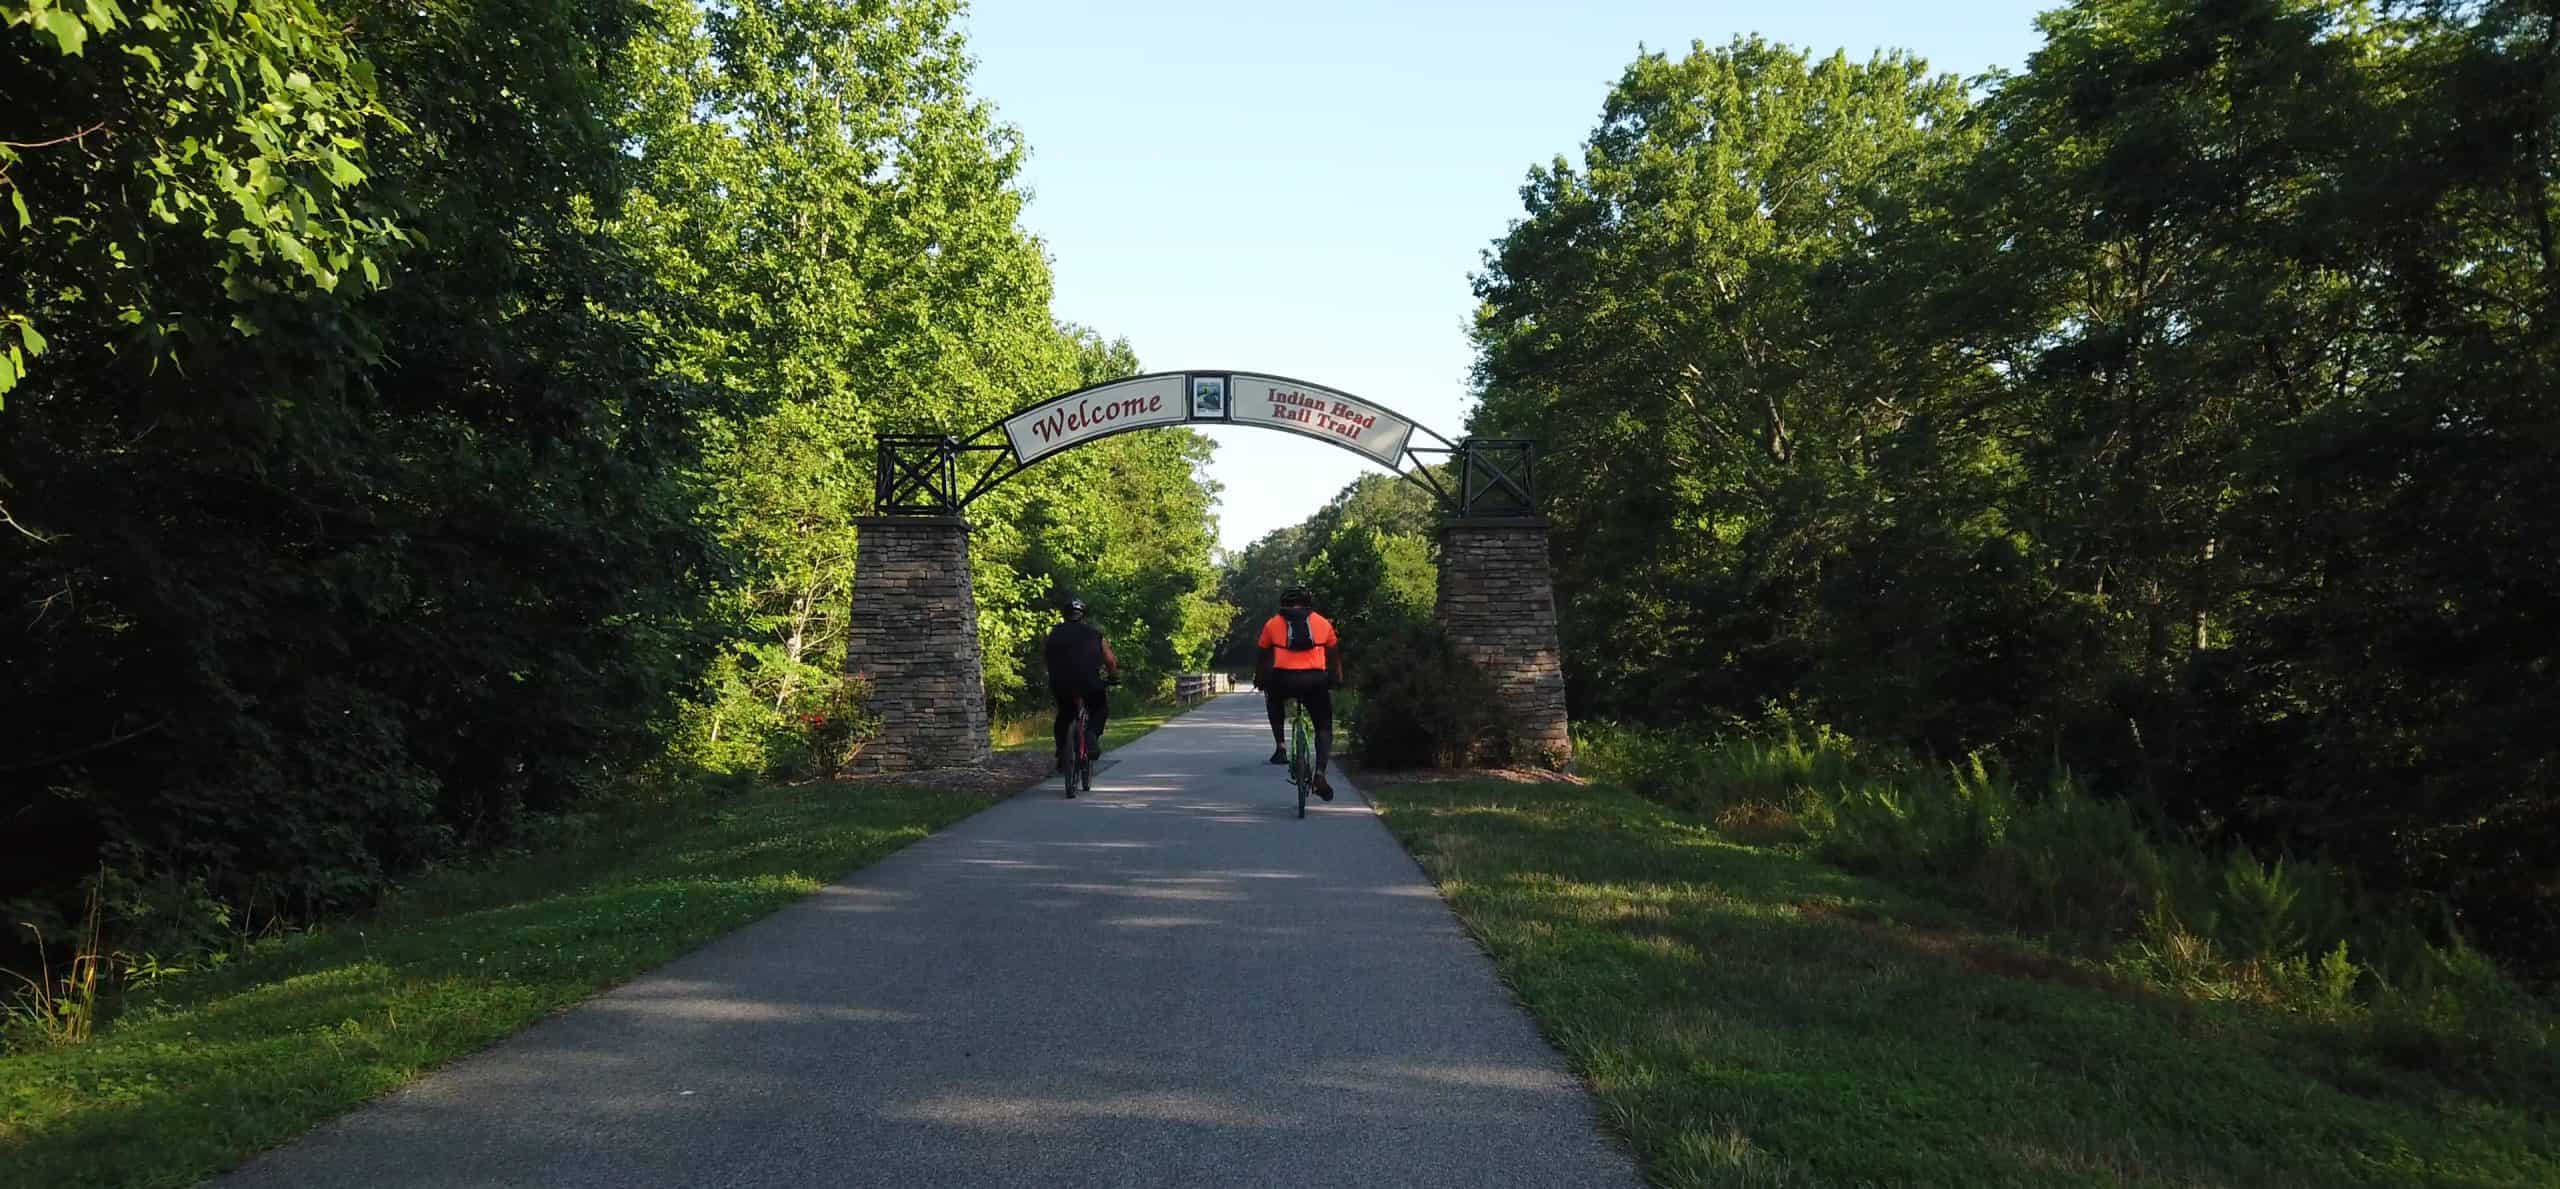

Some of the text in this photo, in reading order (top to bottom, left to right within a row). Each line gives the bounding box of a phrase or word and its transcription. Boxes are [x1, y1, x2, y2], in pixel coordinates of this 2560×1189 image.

[1032, 394, 1162, 443] Welcome
[1268, 388, 1376, 429] Indian Head
[1272, 404, 1362, 440] Rail Trail
